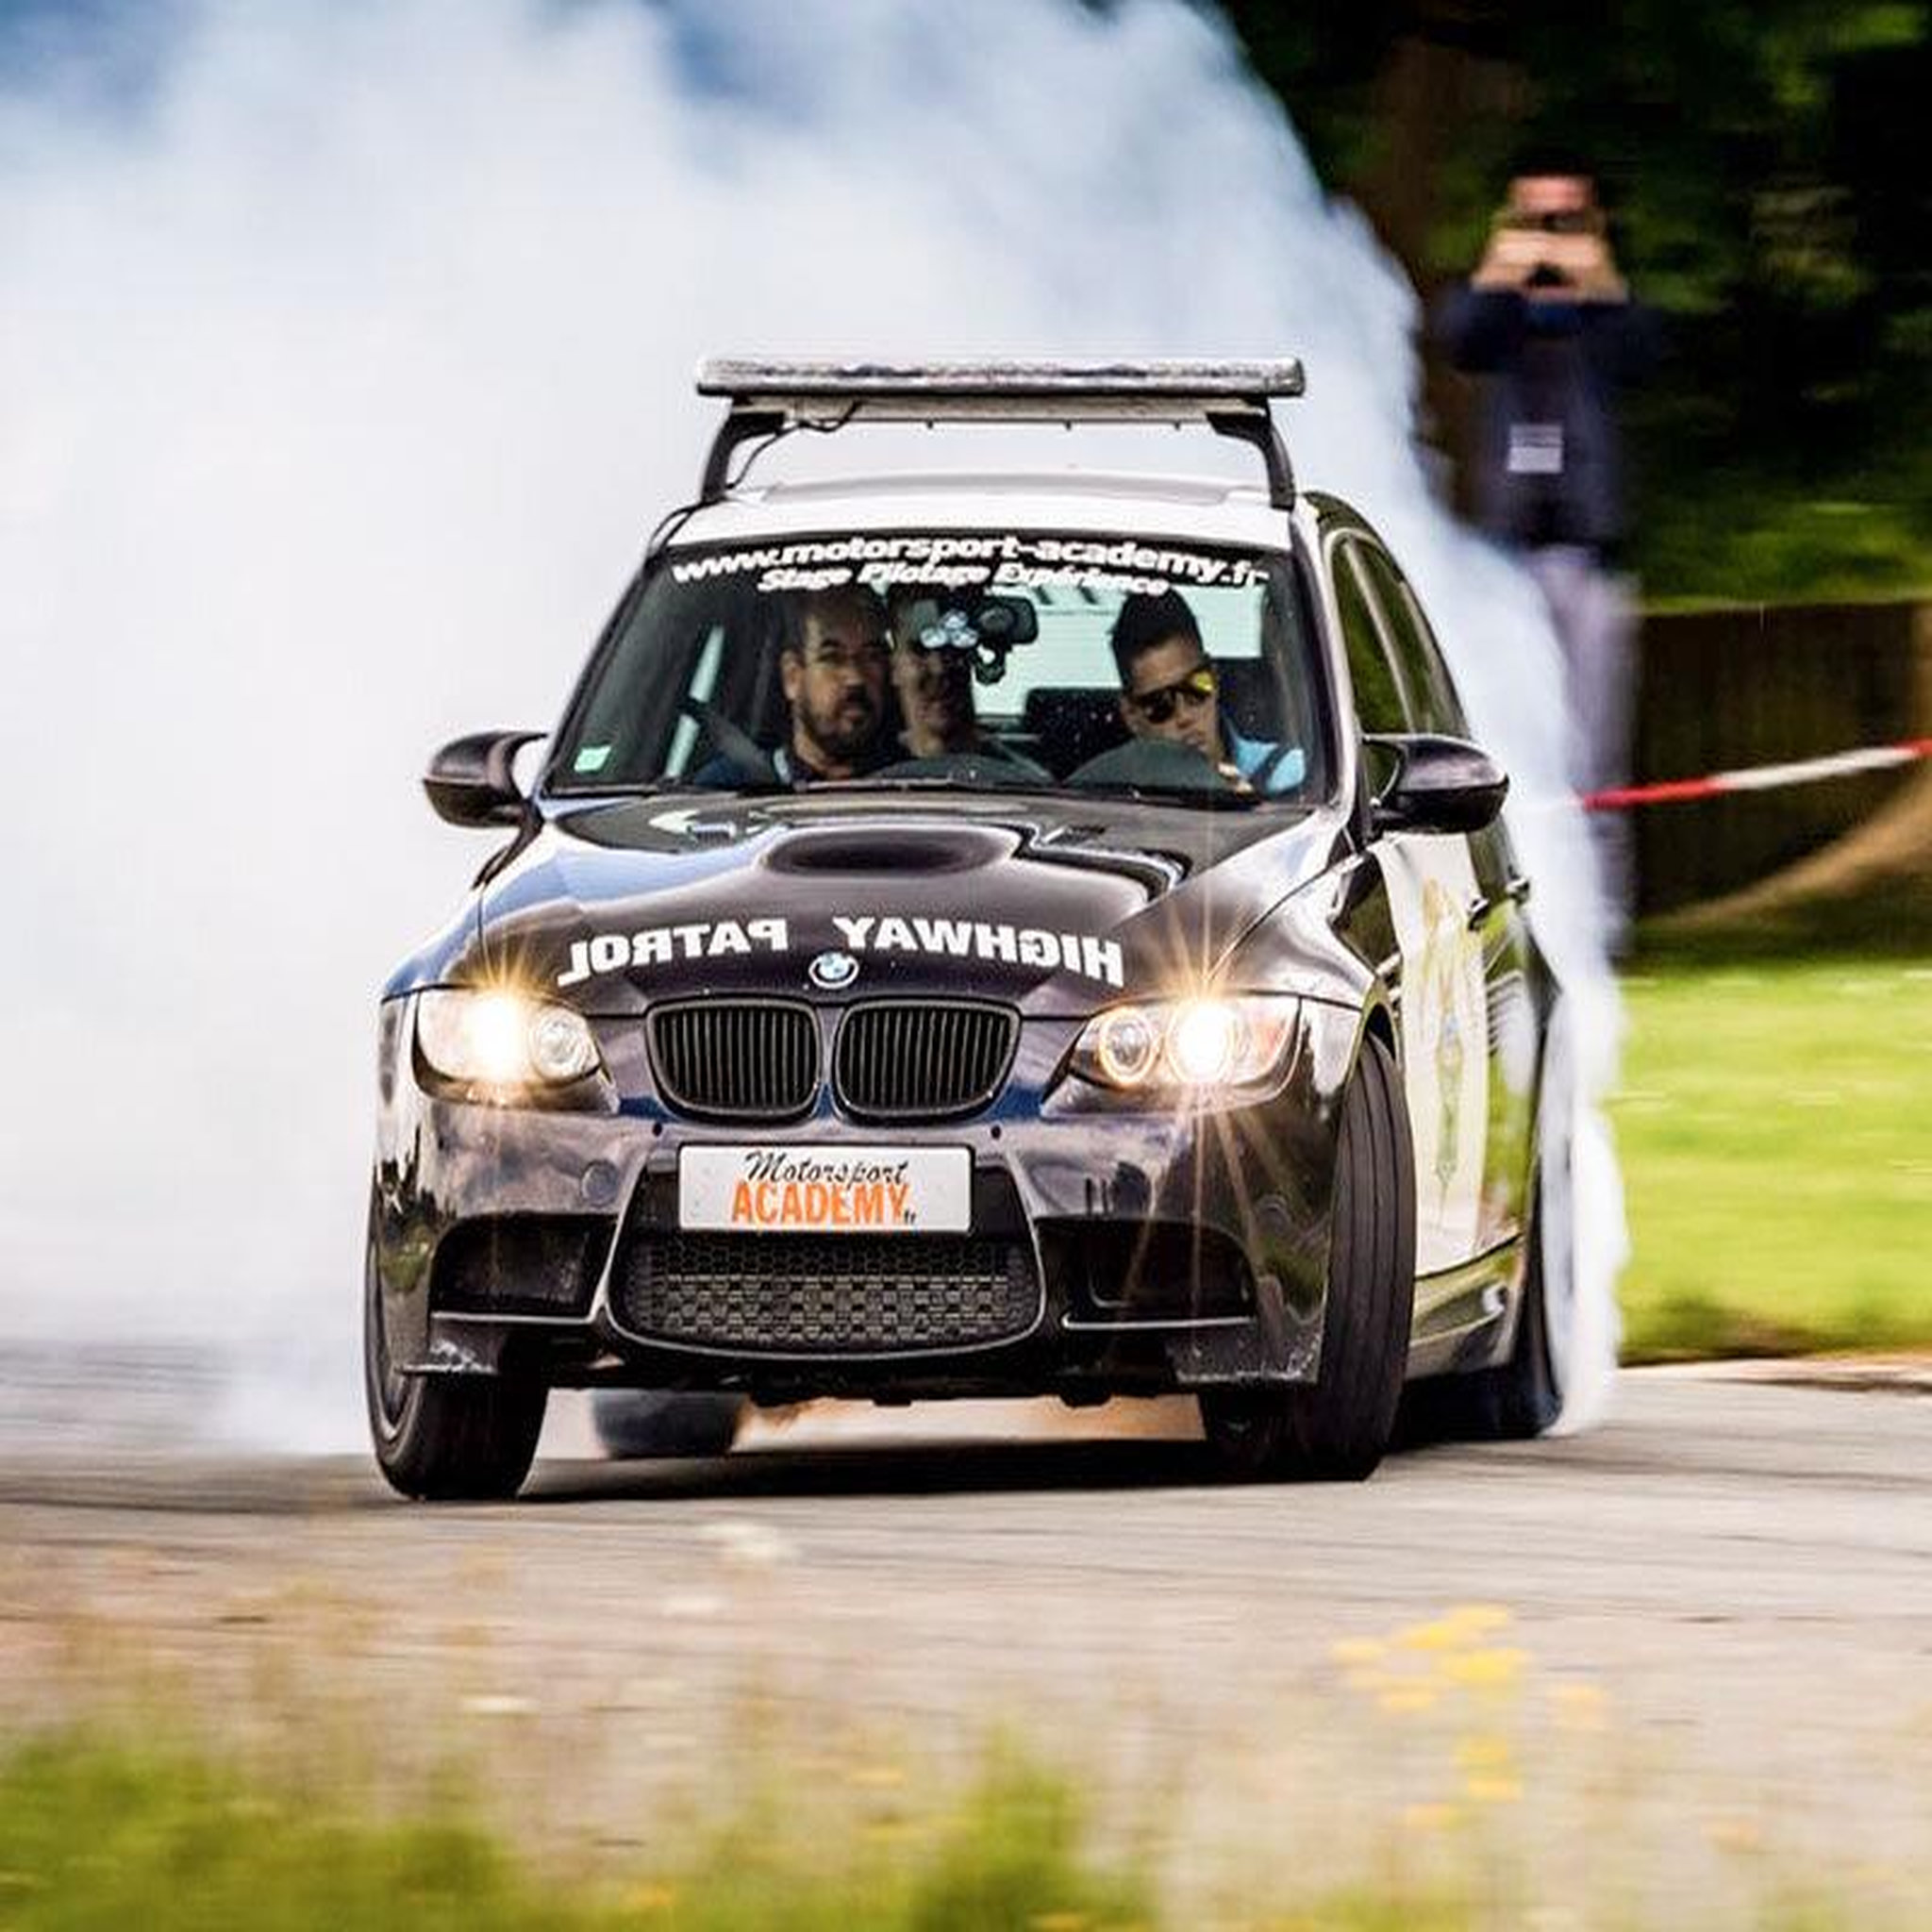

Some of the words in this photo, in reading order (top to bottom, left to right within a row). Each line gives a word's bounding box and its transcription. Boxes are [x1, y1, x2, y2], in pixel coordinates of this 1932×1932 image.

[673, 536, 1270, 585] www.motorsport-academy.fr
[758, 568, 852, 591] Stage
[745, 1150, 909, 1190] Motorsport
[732, 1181, 910, 1224] ACADEMY
